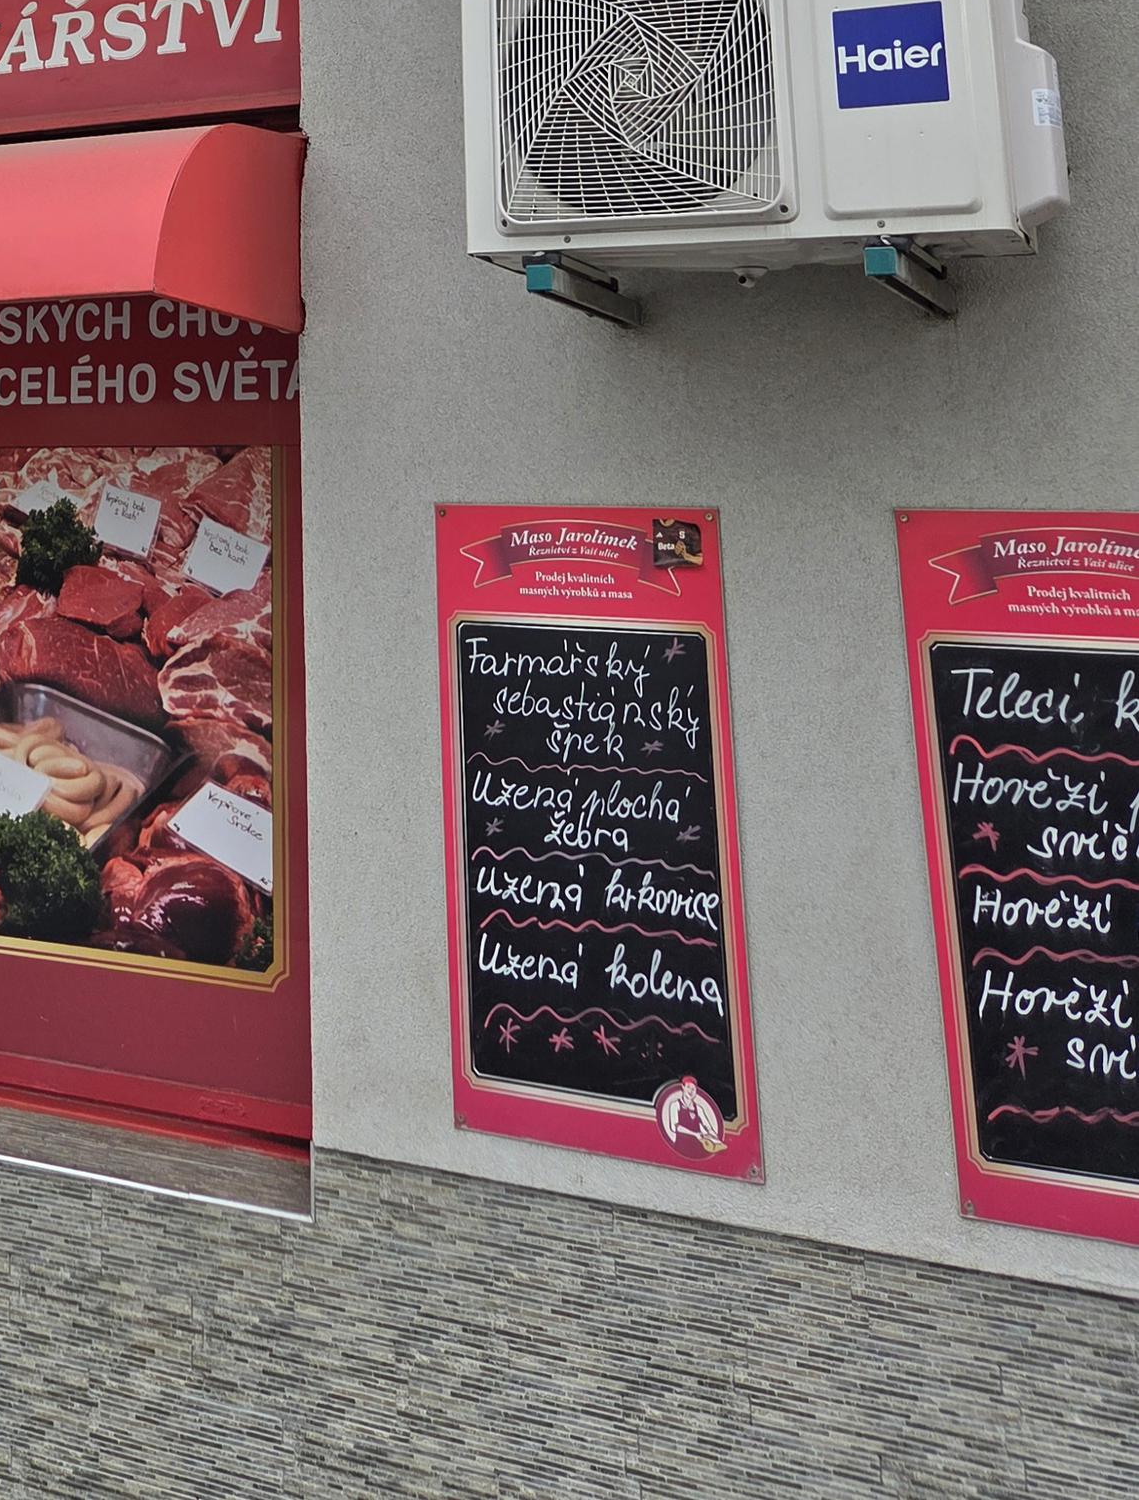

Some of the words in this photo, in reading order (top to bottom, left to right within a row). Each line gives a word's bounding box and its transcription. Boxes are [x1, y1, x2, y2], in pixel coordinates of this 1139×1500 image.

[837, 39, 943, 75] Haier
[510, 530, 552, 547] Maso
[556, 527, 638, 551] Jarolímek
[993, 538, 1047, 558] Maso
[519, 584, 559, 599] masných
[560, 585, 599, 599] výrobků
[600, 590, 607, 599] a
[608, 590, 633, 600] masa
[535, 571, 566, 584] Prodej
[567, 571, 615, 585] kvalitních
[1027, 585, 1067, 601] Prodej
[1008, 602, 1060, 617] masných
[1061, 603, 1112, 618] výrobků
[1113, 607, 1122, 617] a
[465, 637, 651, 698] Farmářský
[492, 678, 700, 749] sebastiánský
[950, 668, 1085, 724] Telecí
[546, 720, 625, 763] špek
[581, 779, 691, 828] plochá
[543, 810, 629, 852] žebra
[1066, 1034, 1138, 1080] sví
